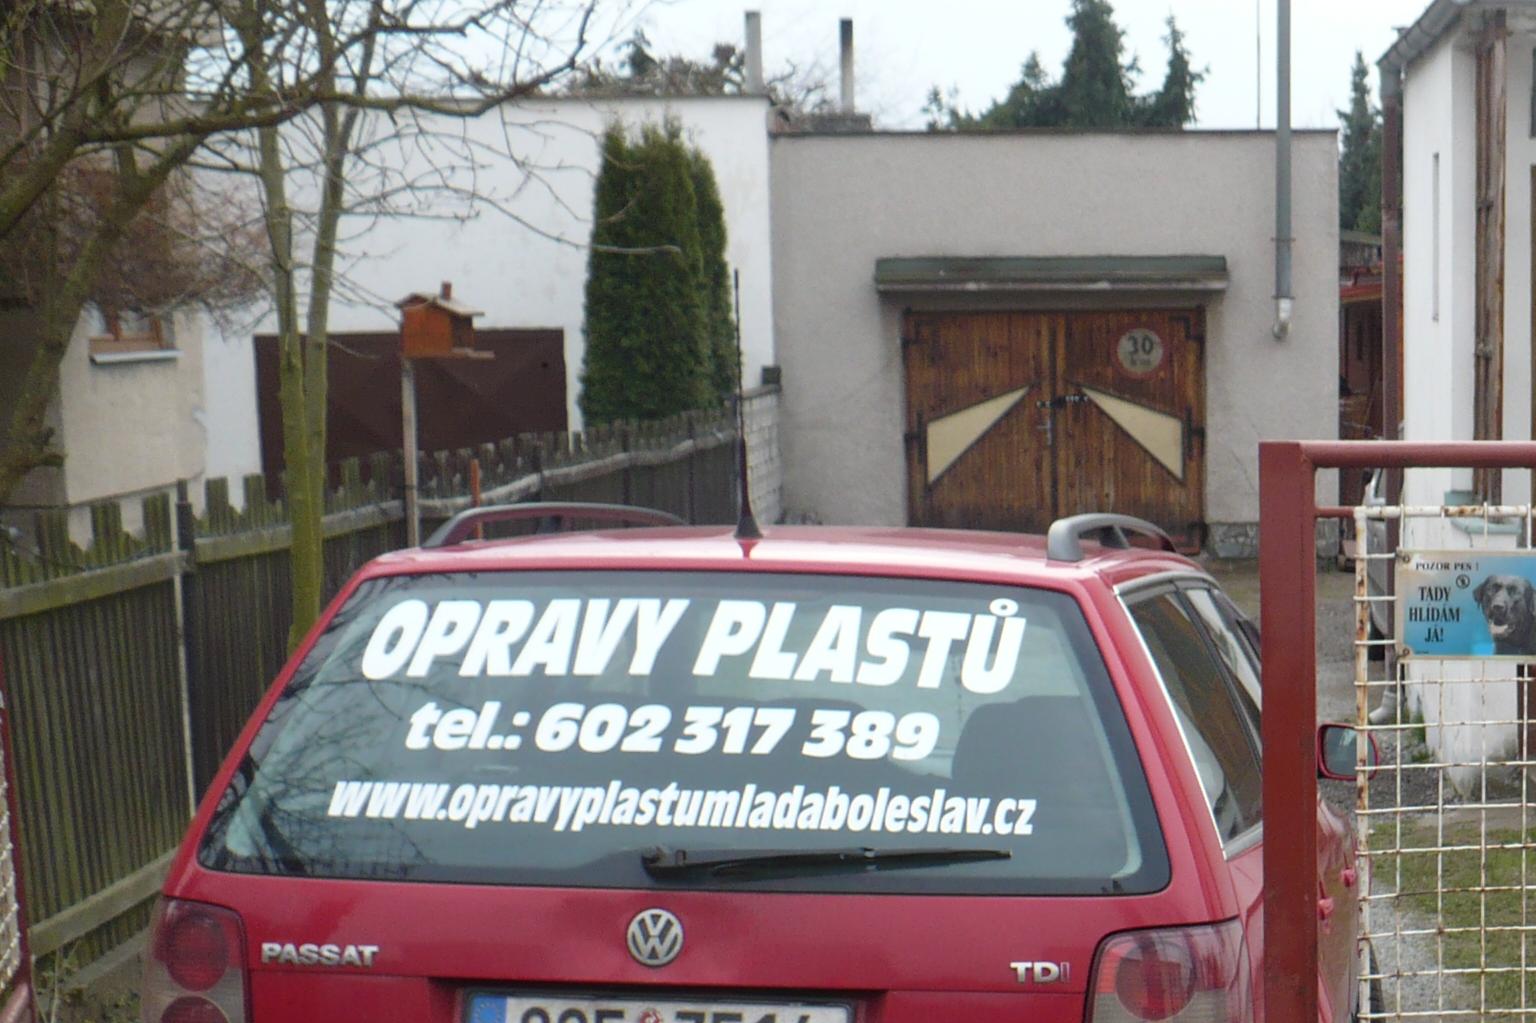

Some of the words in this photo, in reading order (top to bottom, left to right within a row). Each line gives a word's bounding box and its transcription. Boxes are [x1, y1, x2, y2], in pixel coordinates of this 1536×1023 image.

[1416, 561, 1450, 571] POZOR
[1419, 586, 1450, 601] TADY
[1409, 604, 1460, 622] HLÍDÁM
[361, 598, 690, 679] OPRAVY
[692, 597, 1027, 694] PLASTŮ
[1424, 625, 1444, 643] JÁ!
[405, 700, 530, 750] tel.:
[534, 703, 670, 752] 602
[675, 706, 797, 755] 317
[801, 710, 939, 761] 389
[328, 776, 1037, 836] www.opravyplastumladaboleslav.cz
[261, 942, 378, 967] PASSAT
[1010, 960, 1069, 983] TDI
